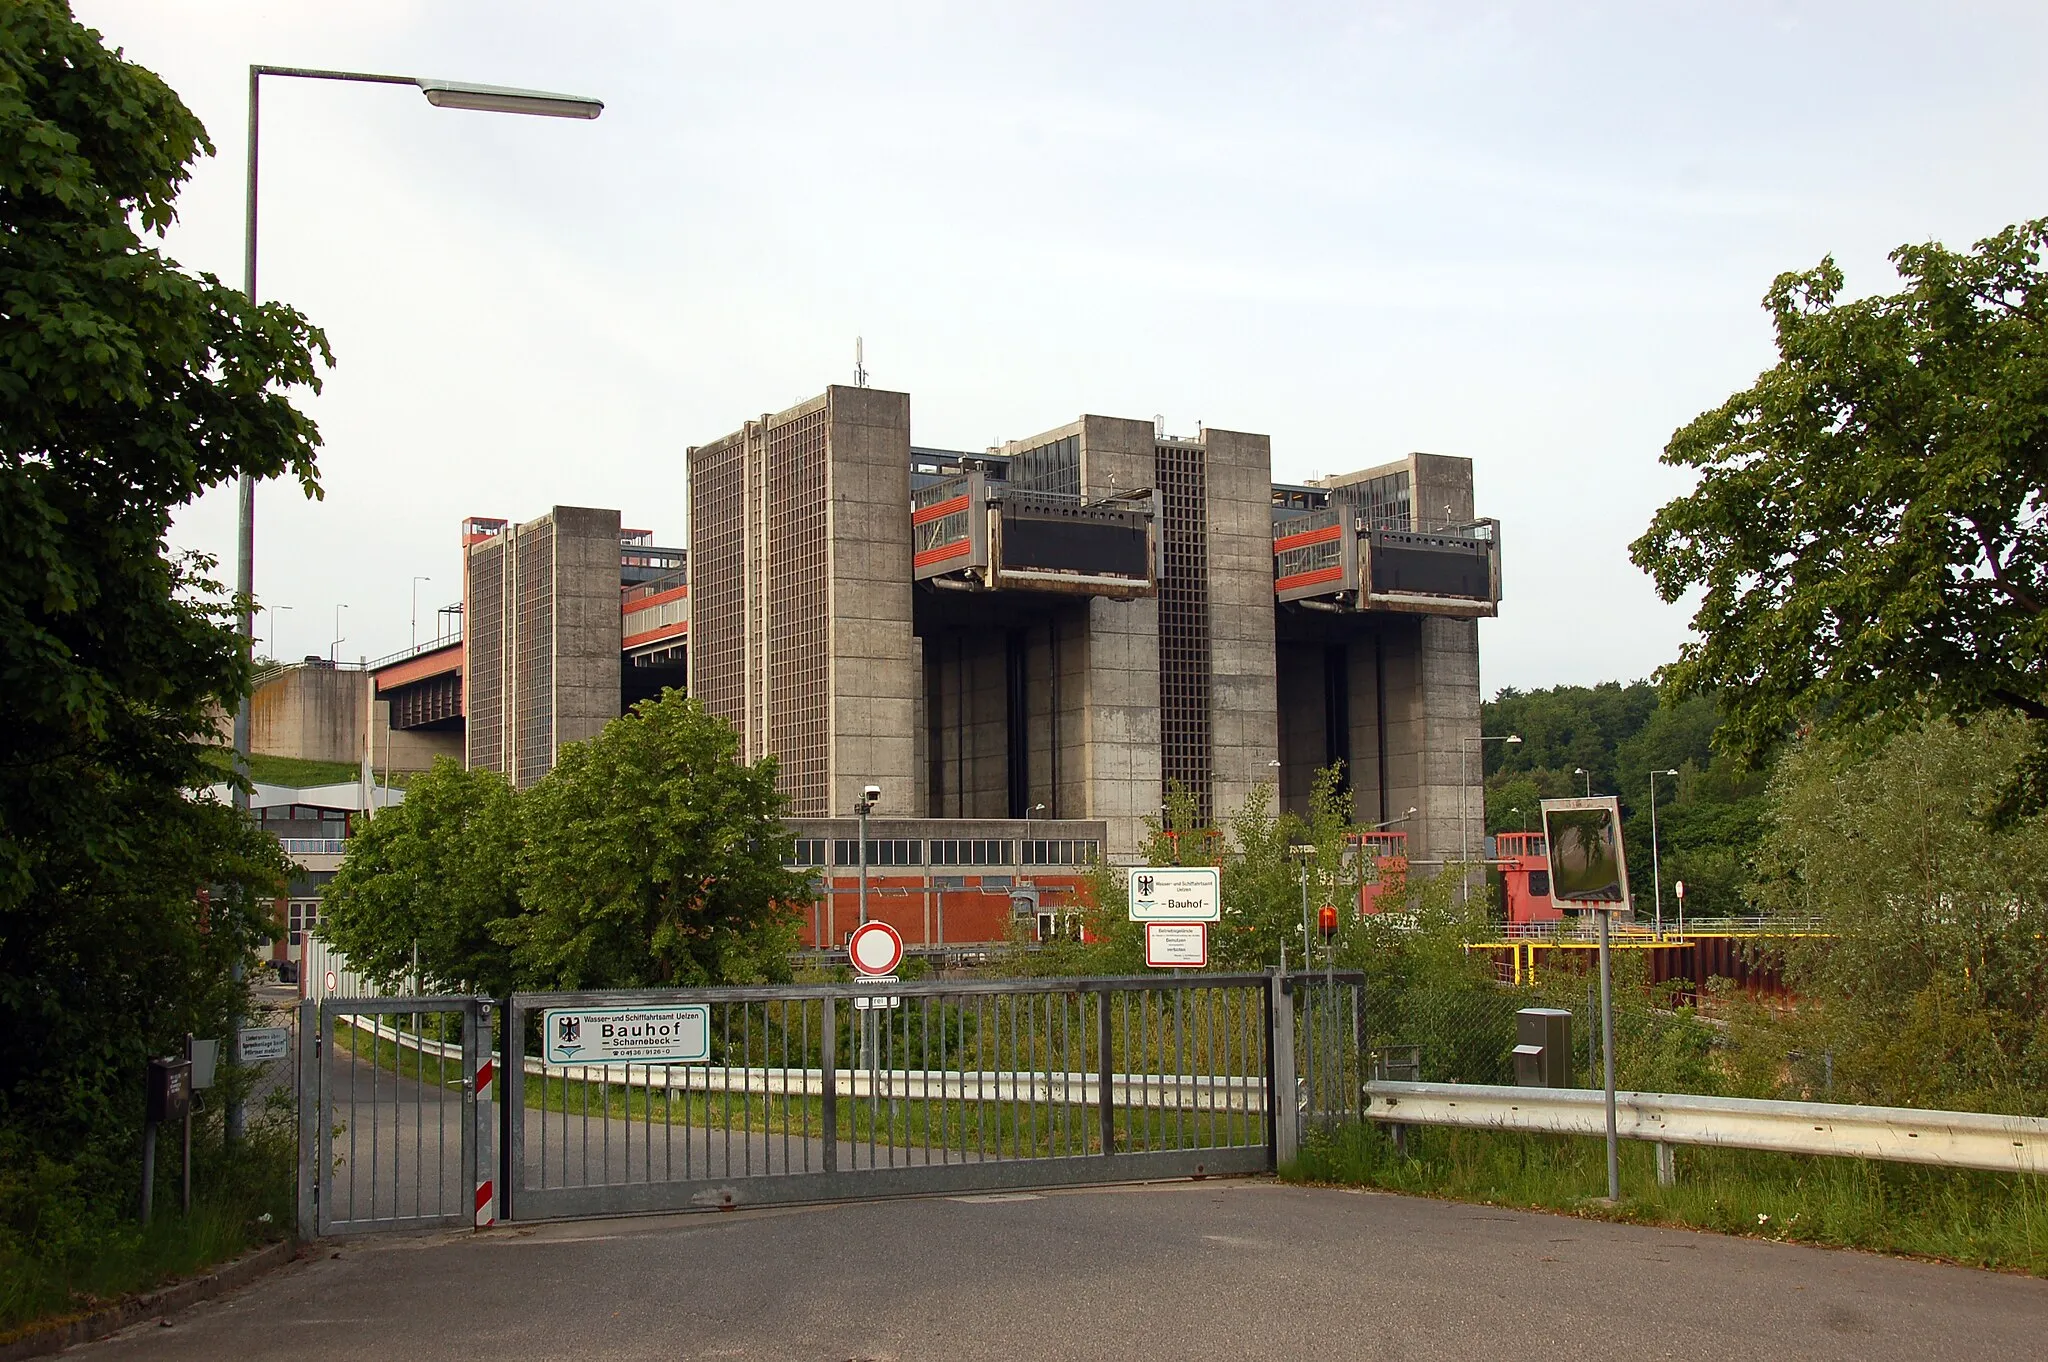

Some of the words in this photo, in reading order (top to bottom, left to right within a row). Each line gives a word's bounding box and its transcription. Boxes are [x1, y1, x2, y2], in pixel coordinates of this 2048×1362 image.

[1168, 899, 1203, 908] Bauhof
[583, 1015, 611, 1023] Wasser-
[612, 1014, 624, 1022] und
[602, 1022, 680, 1038] Bauhof
[613, 1037, 670, 1046] Scharnebeck
